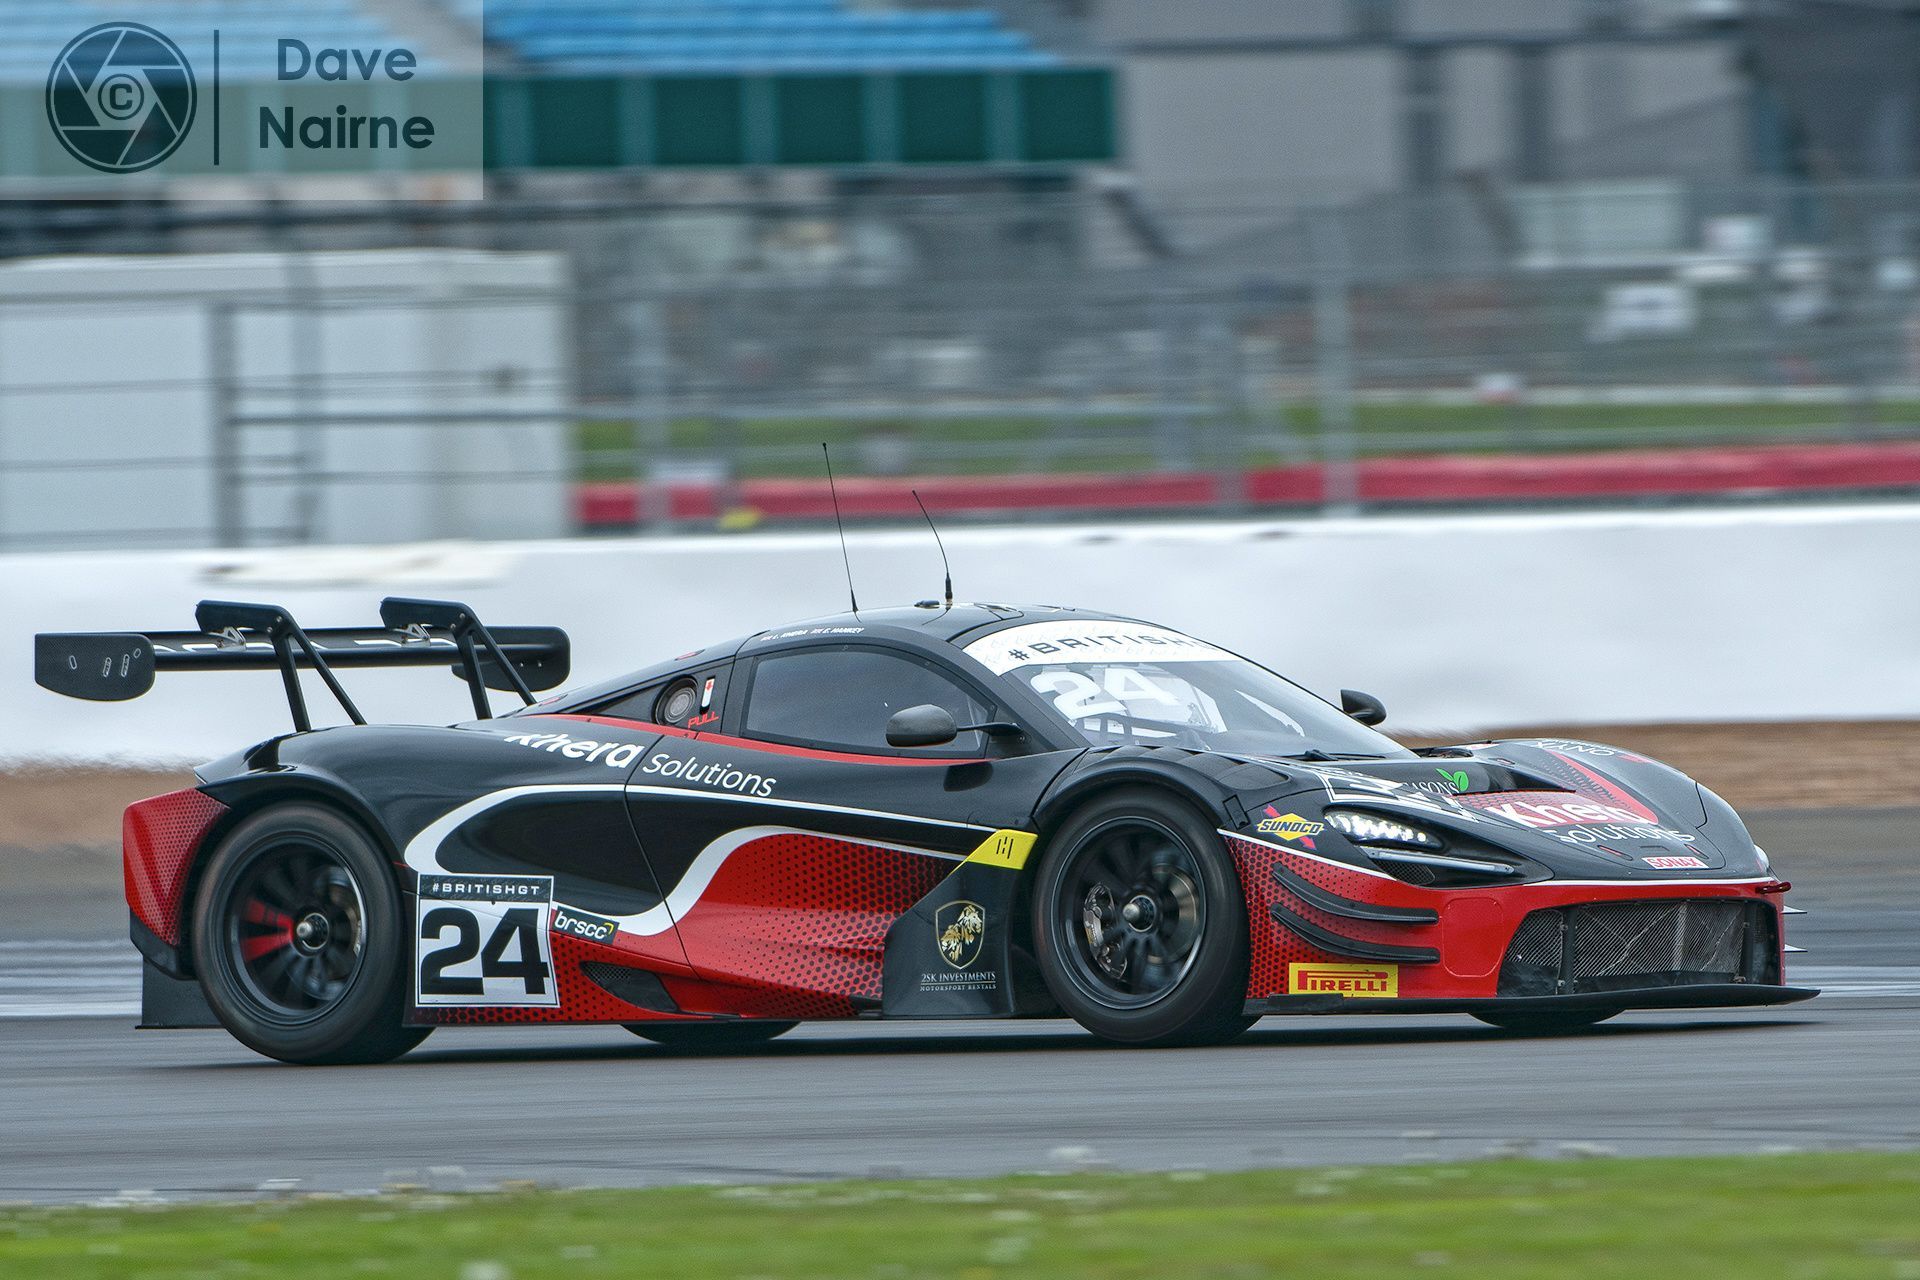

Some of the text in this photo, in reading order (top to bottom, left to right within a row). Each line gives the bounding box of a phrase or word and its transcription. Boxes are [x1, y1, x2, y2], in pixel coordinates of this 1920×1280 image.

[1030, 667, 1181, 721] 24
[687, 711, 720, 730] PULL
[1260, 820, 1322, 835] SUNOCO
[432, 883, 540, 896] #BRITISHGT
[554, 911, 609, 940] brscc
[420, 907, 550, 995] 24
[939, 971, 996, 982] INVESTMENTS
[1297, 970, 1389, 992] PIRELLI
[920, 984, 965, 992] MOTORSPORT
